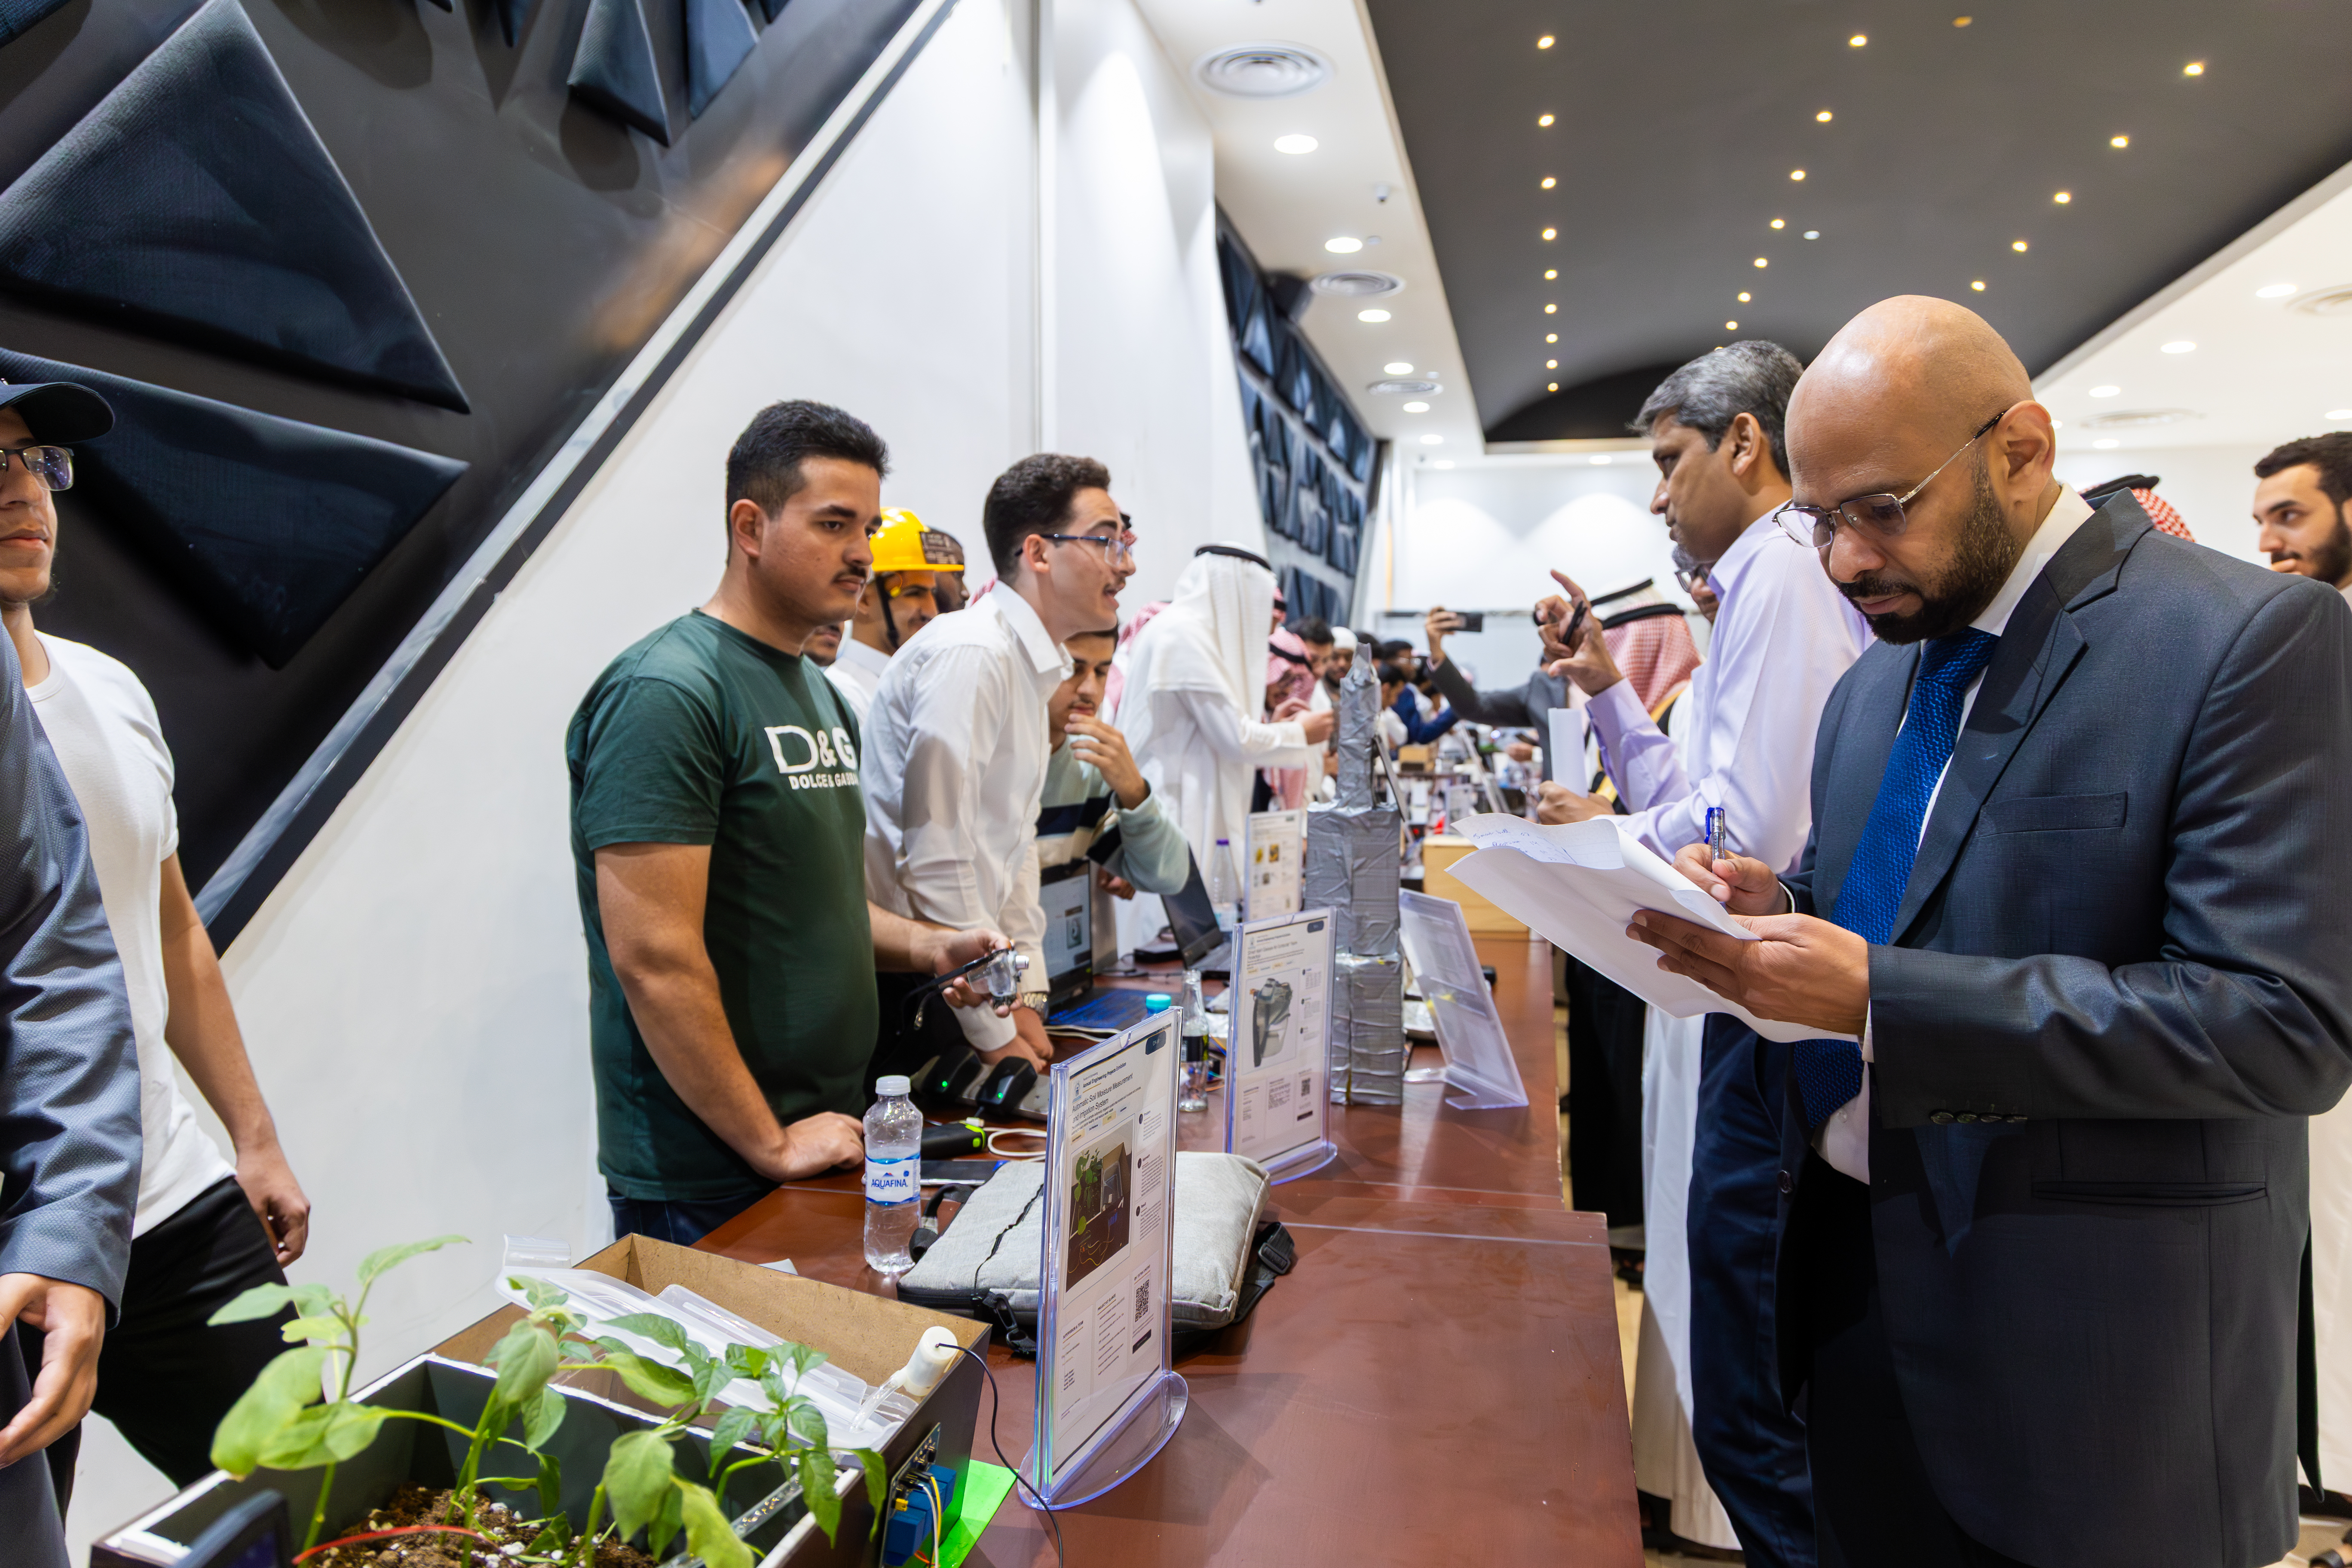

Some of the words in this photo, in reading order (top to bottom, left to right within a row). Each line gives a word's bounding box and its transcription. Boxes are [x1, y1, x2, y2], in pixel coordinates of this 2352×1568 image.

[764, 725, 858, 773] D&G
[1083, 1080, 1091, 1088] Annual
[1091, 1073, 1107, 1084] Engineering
[1072, 1097, 1089, 1113] Automatic
[1097, 1085, 1112, 1099] Moisture
[1112, 1072, 1133, 1090] Measurement
[1079, 1105, 1095, 1119] Irrigation
[1096, 1098, 1109, 1111] System
[871, 1179, 907, 1189] AQUAFINA
